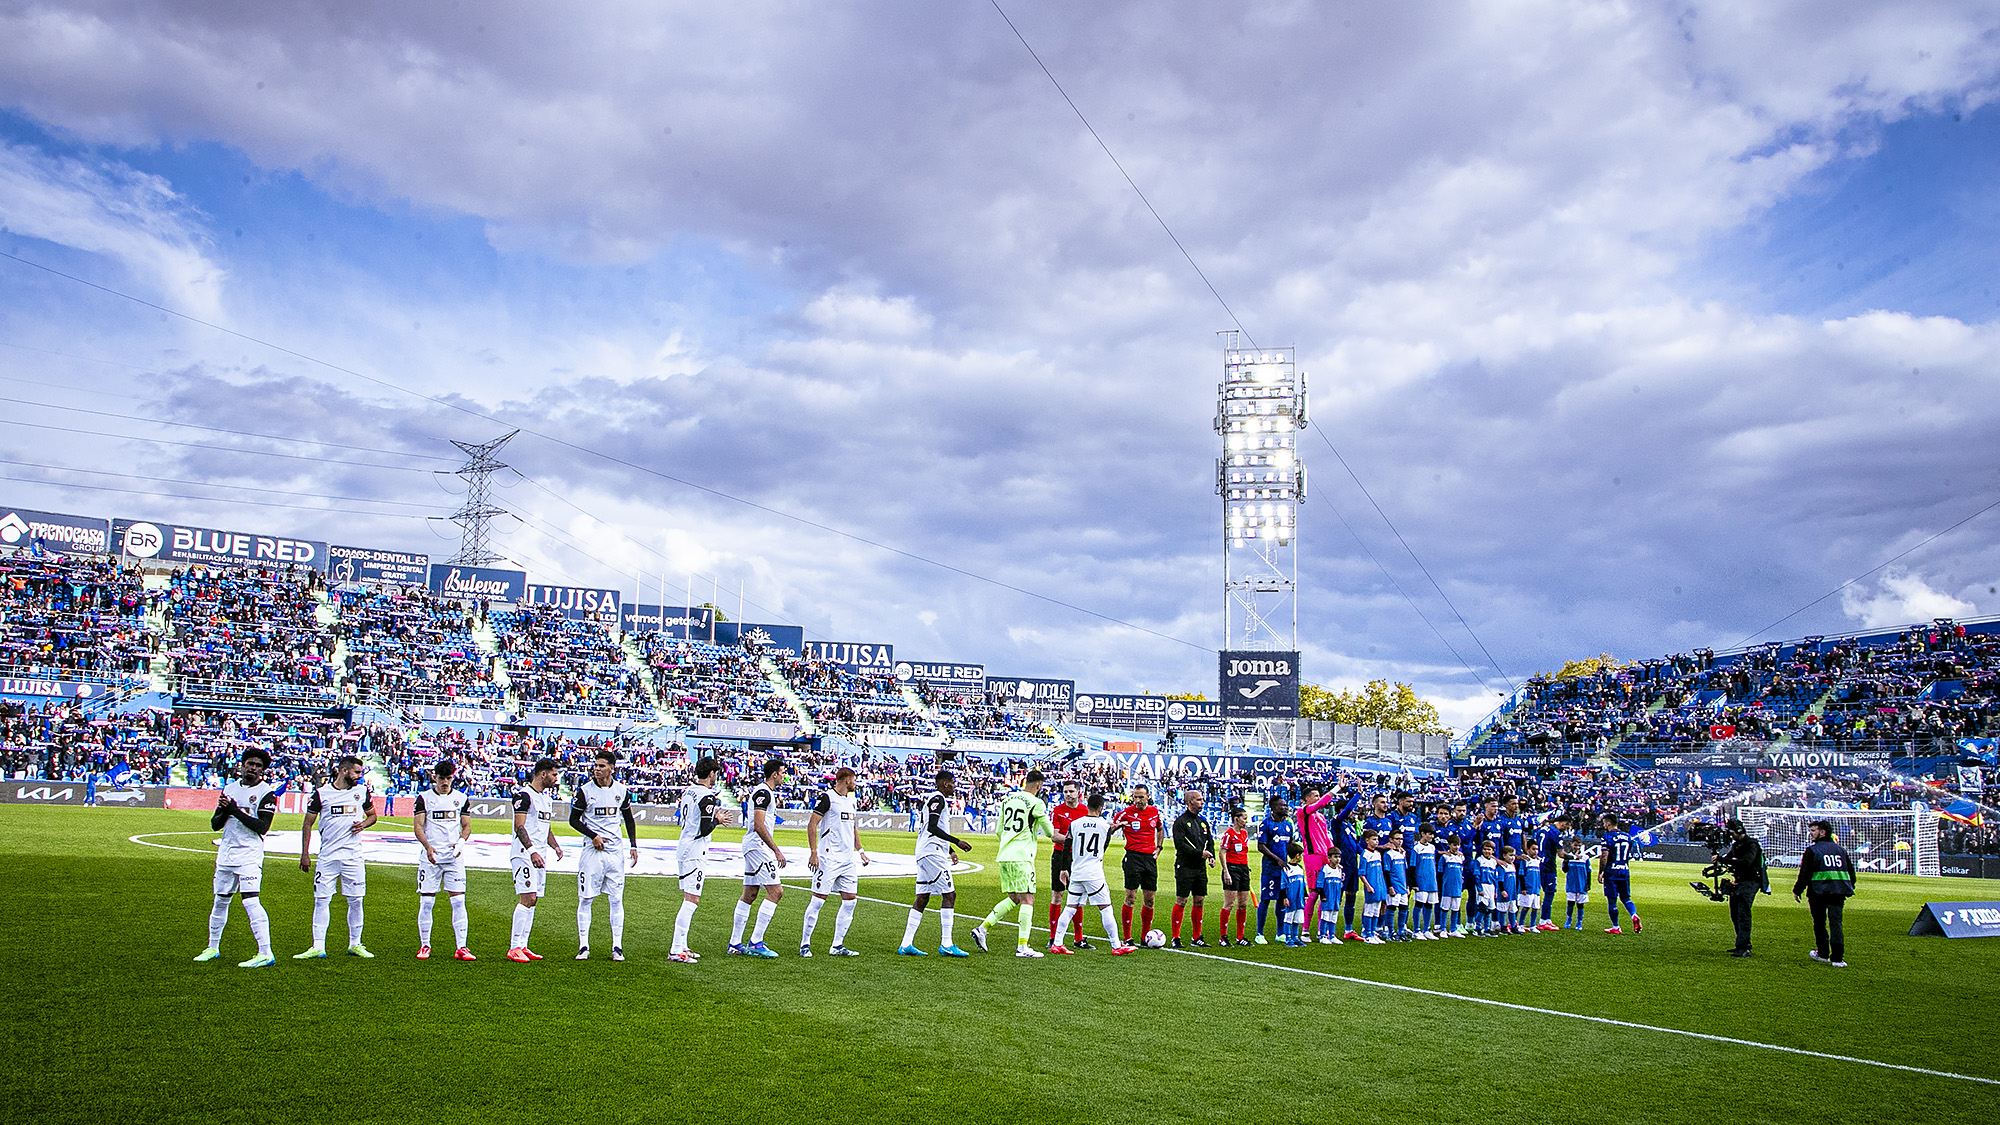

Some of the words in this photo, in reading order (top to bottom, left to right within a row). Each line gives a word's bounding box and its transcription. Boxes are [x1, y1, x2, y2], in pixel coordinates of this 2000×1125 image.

[28, 521, 105, 546] TECNOCASA
[130, 533, 158, 548] BR
[173, 528, 250, 556] BLUE
[257, 537, 315, 562] RED
[71, 543, 105, 552] GROUP
[172, 550, 232, 563] REHABILITACIÓN
[363, 561, 396, 571] LIMPIEZA
[397, 564, 424, 573] DENTAL
[381, 571, 407, 579] GRATIS
[444, 567, 510, 595] Bulevar
[528, 586, 618, 613] LUJISA
[624, 614, 663, 624] vamos
[762, 645, 796, 657] Ricardo
[805, 642, 892, 666] LUJISA
[913, 664, 952, 678] BLUE
[953, 666, 984, 679] RED
[2, 679, 63, 696] LUJISA
[1094, 697, 1133, 709] BLUE
[1135, 698, 1166, 711] RED
[436, 707, 484, 722] LUJISA
[720, 723, 728, 734] 0
[735, 727, 761, 737] 45:00
[770, 726, 777, 737] 0
[857, 733, 915, 748] AMOVIL
[1470, 754, 1504, 767] Lowi
[1504, 757, 1522, 765] Fibra
[1550, 757, 1561, 765] 5G
[1655, 755, 1682, 766] getafe
[1768, 752, 1850, 767] YAMOVIL
[1116, 753, 1240, 780] YAMOVIL
[1254, 759, 1310, 773] COCHES
[16, 786, 74, 801] KIA
[653, 814, 672, 822] Autos
[857, 818, 893, 829] KIA
[1003, 806, 1025, 833] 25
[1077, 832, 1100, 857] 14
[1614, 841, 1630, 861] 17
[763, 860, 777, 873] 15
[1823, 854, 1843, 868] 015
[419, 869, 426, 882] 6
[522, 866, 531, 879] 9
[696, 870, 703, 882] 8
[816, 870, 824, 882] 2
[943, 870, 951, 881] 3
[1941, 865, 1970, 875] Selikar
[579, 871, 586, 884] 5
[1268, 879, 1275, 890] 2
